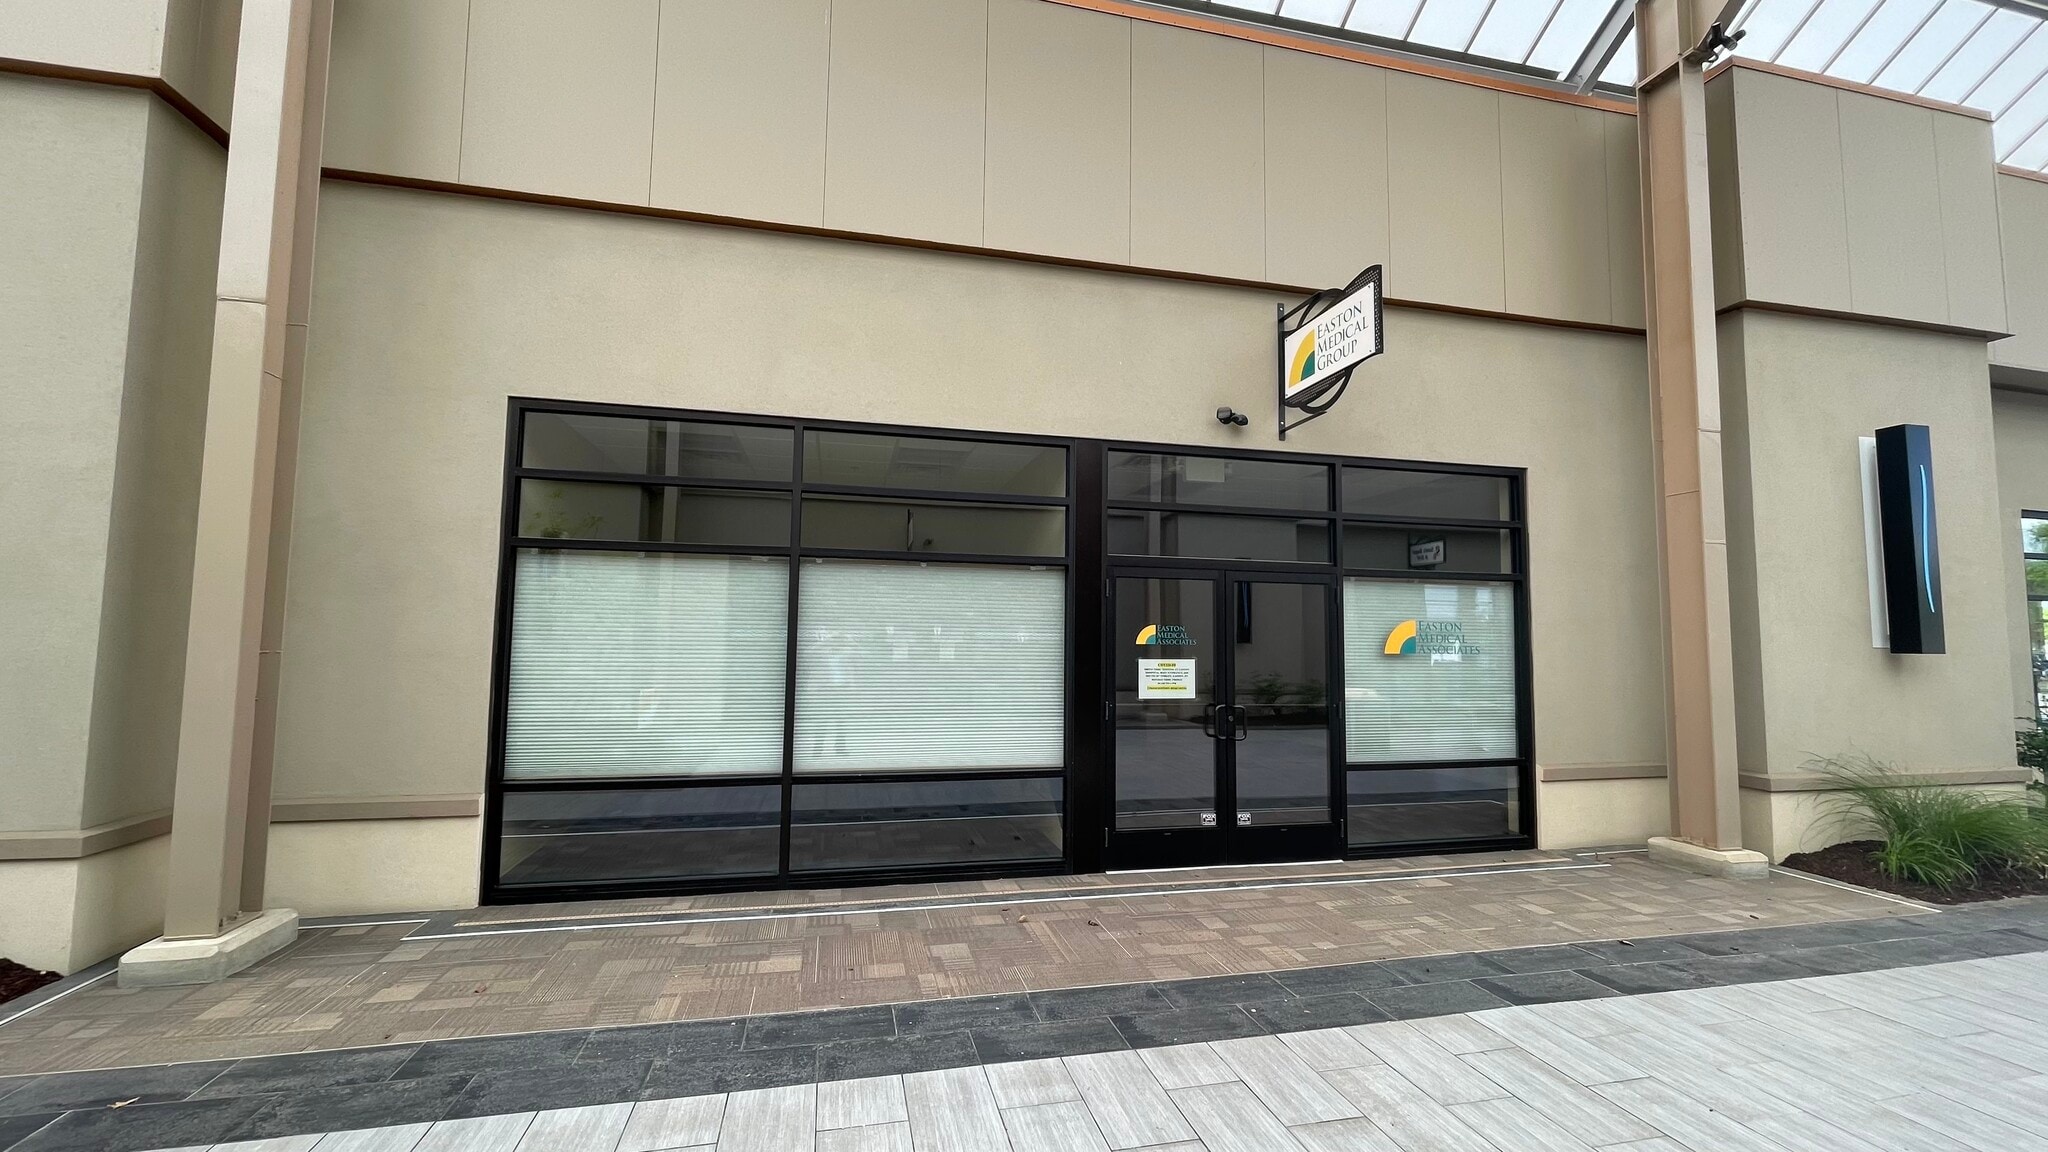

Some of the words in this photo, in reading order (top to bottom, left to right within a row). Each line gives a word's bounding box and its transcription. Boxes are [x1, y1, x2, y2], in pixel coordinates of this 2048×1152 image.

[1317, 301, 1362, 340] EASTON
[1317, 316, 1369, 356] MEDICAL
[1317, 339, 1358, 371] GROUP
[1417, 620, 1462, 632] EASTON
[1157, 638, 1197, 646] ASSOCIATES
[1417, 633, 1468, 643] MEDICAL
[1417, 644, 1481, 655] ASSOCIATES
